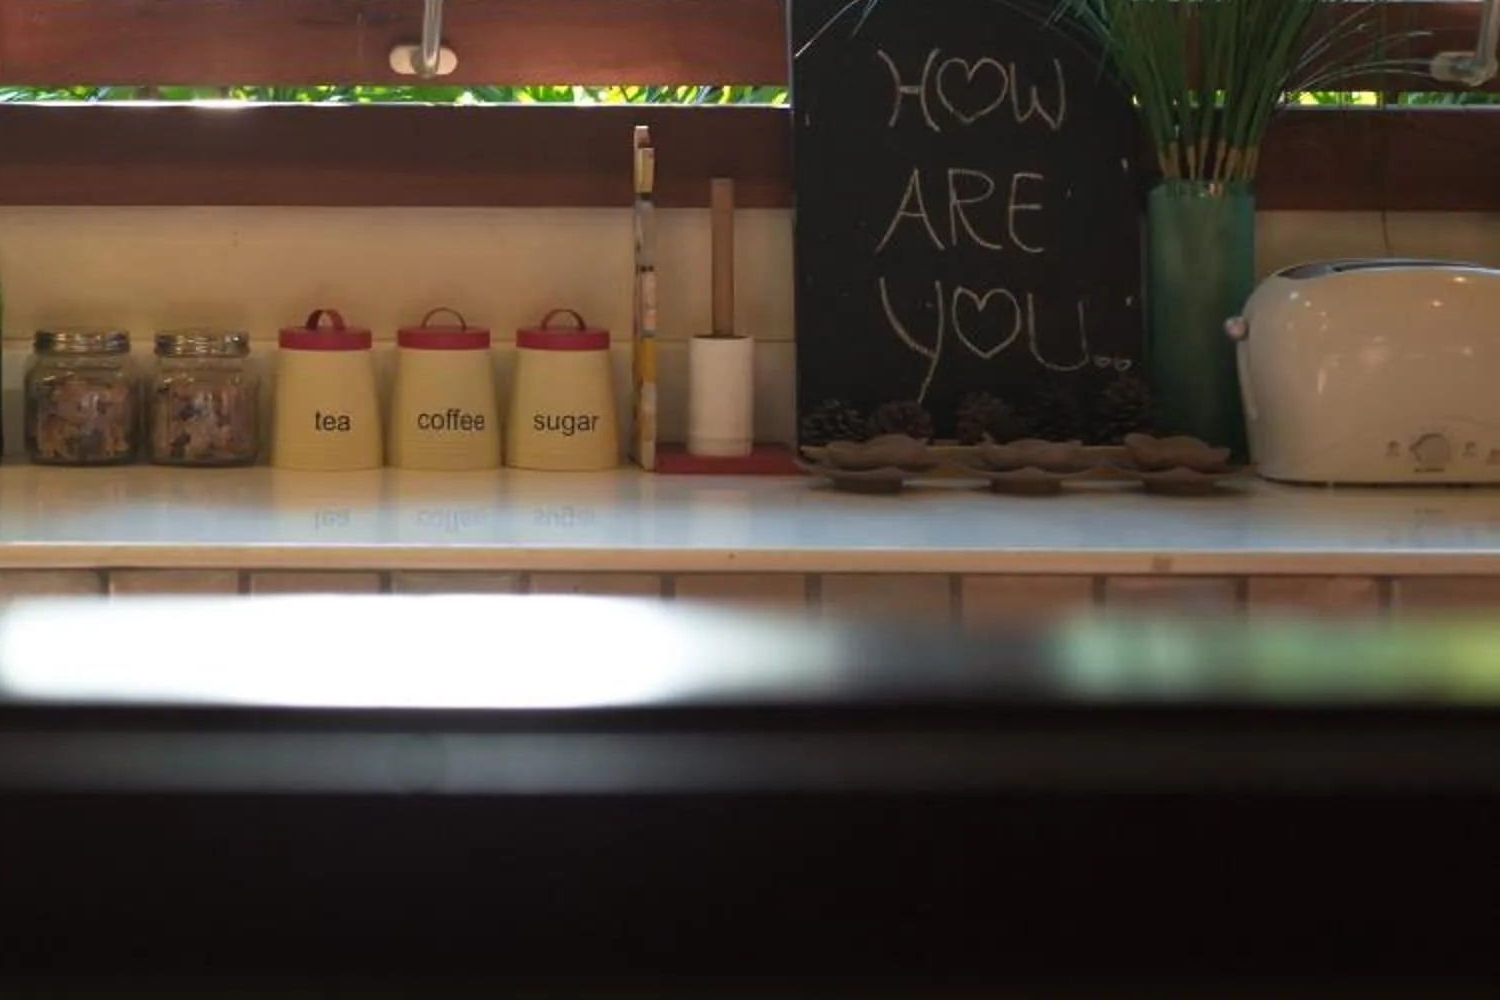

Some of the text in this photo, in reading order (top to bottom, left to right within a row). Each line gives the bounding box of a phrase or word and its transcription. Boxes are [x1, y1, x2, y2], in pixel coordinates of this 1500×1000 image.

[877, 48, 1066, 132] HOW
[875, 167, 1045, 253] ARE
[315, 411, 350, 431] tea
[417, 409, 485, 431] coffee
[533, 412, 600, 436] sugar
